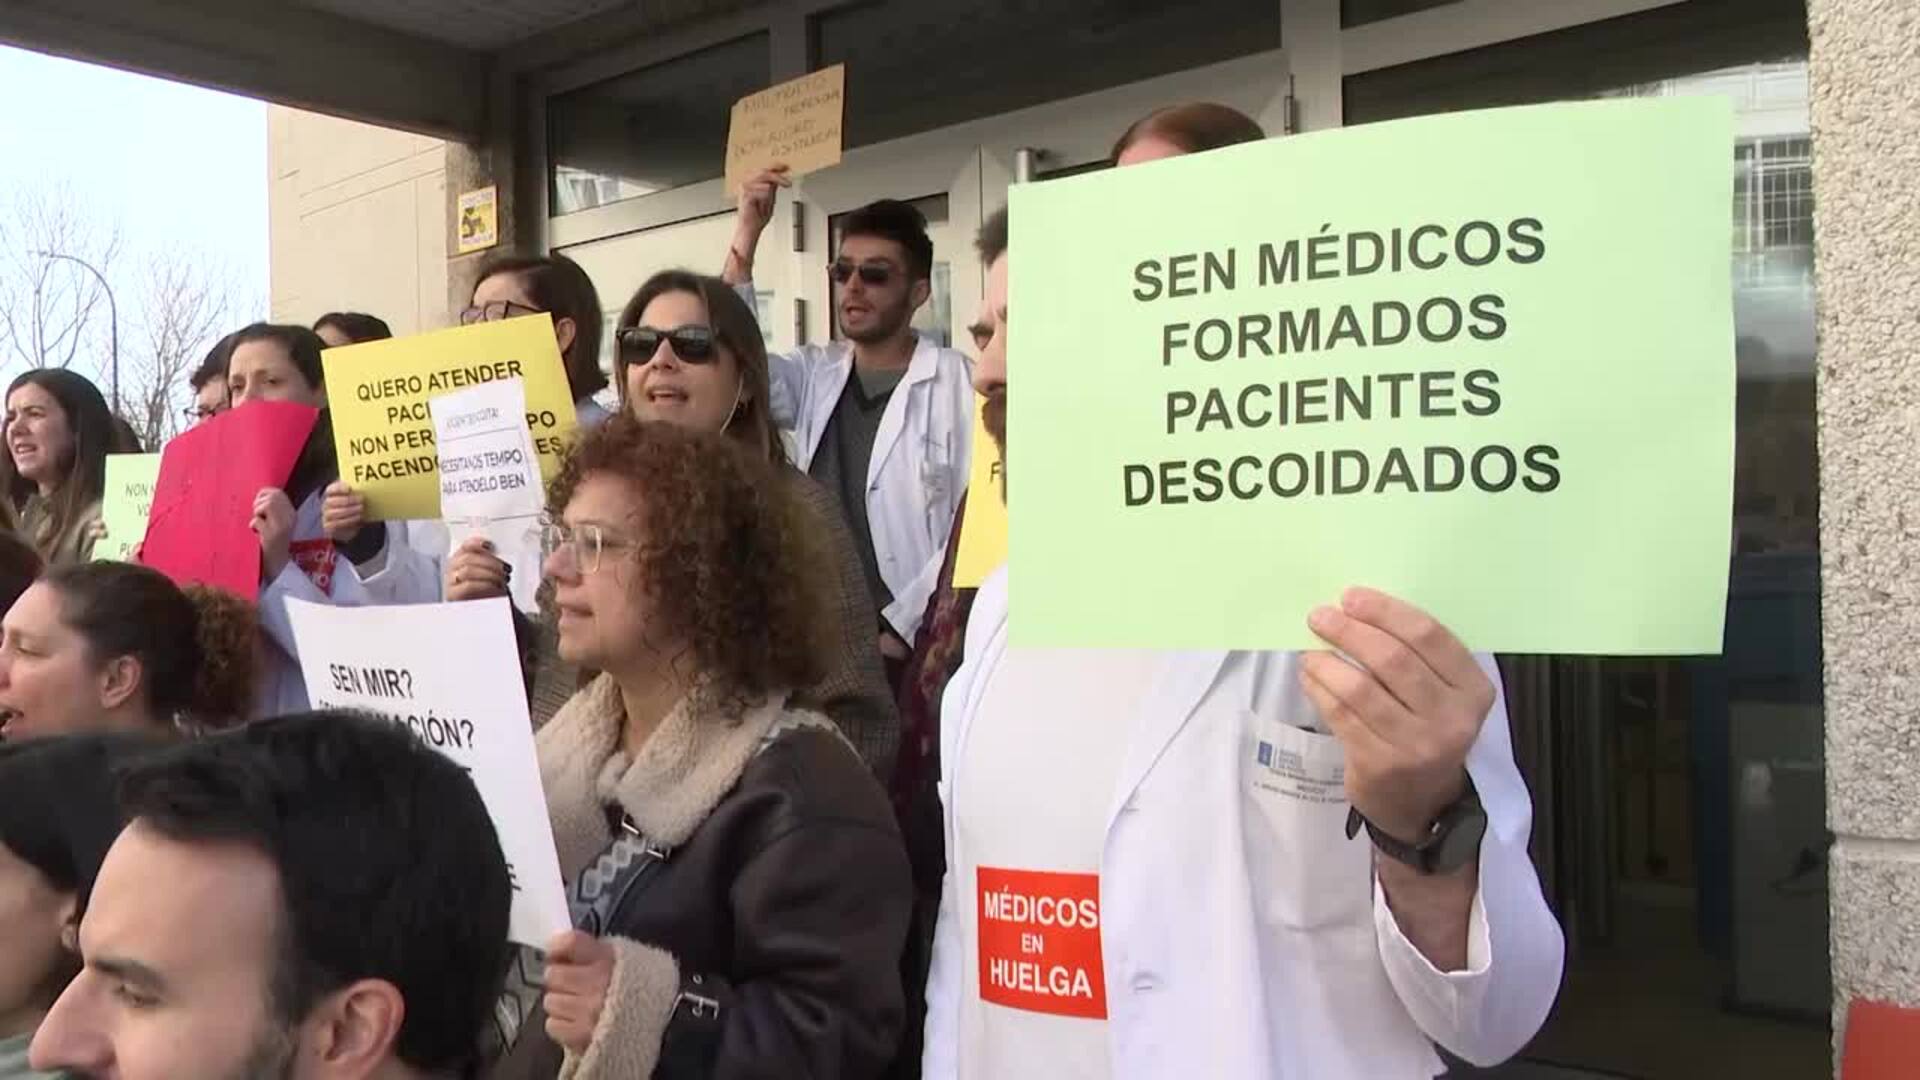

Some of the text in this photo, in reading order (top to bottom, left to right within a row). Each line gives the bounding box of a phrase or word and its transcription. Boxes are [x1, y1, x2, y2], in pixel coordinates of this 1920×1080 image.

[1132, 217, 1546, 303] SEN MÉDICOS
[1162, 293, 1508, 366] FORMADOS
[357, 359, 524, 402] QUERO ATENDER
[1166, 368, 1503, 434] PACIENTES
[350, 434, 389, 457] NON
[394, 429, 434, 450] PER
[484, 448, 524, 469] TEMPO
[500, 472, 526, 489] BEN
[1123, 444, 1561, 507] DESCOIDADOS
[330, 662, 415, 699] SEN MIR?
[984, 884, 1099, 930] MÉDICOS
[1020, 931, 1044, 955] EN
[989, 956, 1093, 999] HUELGA
